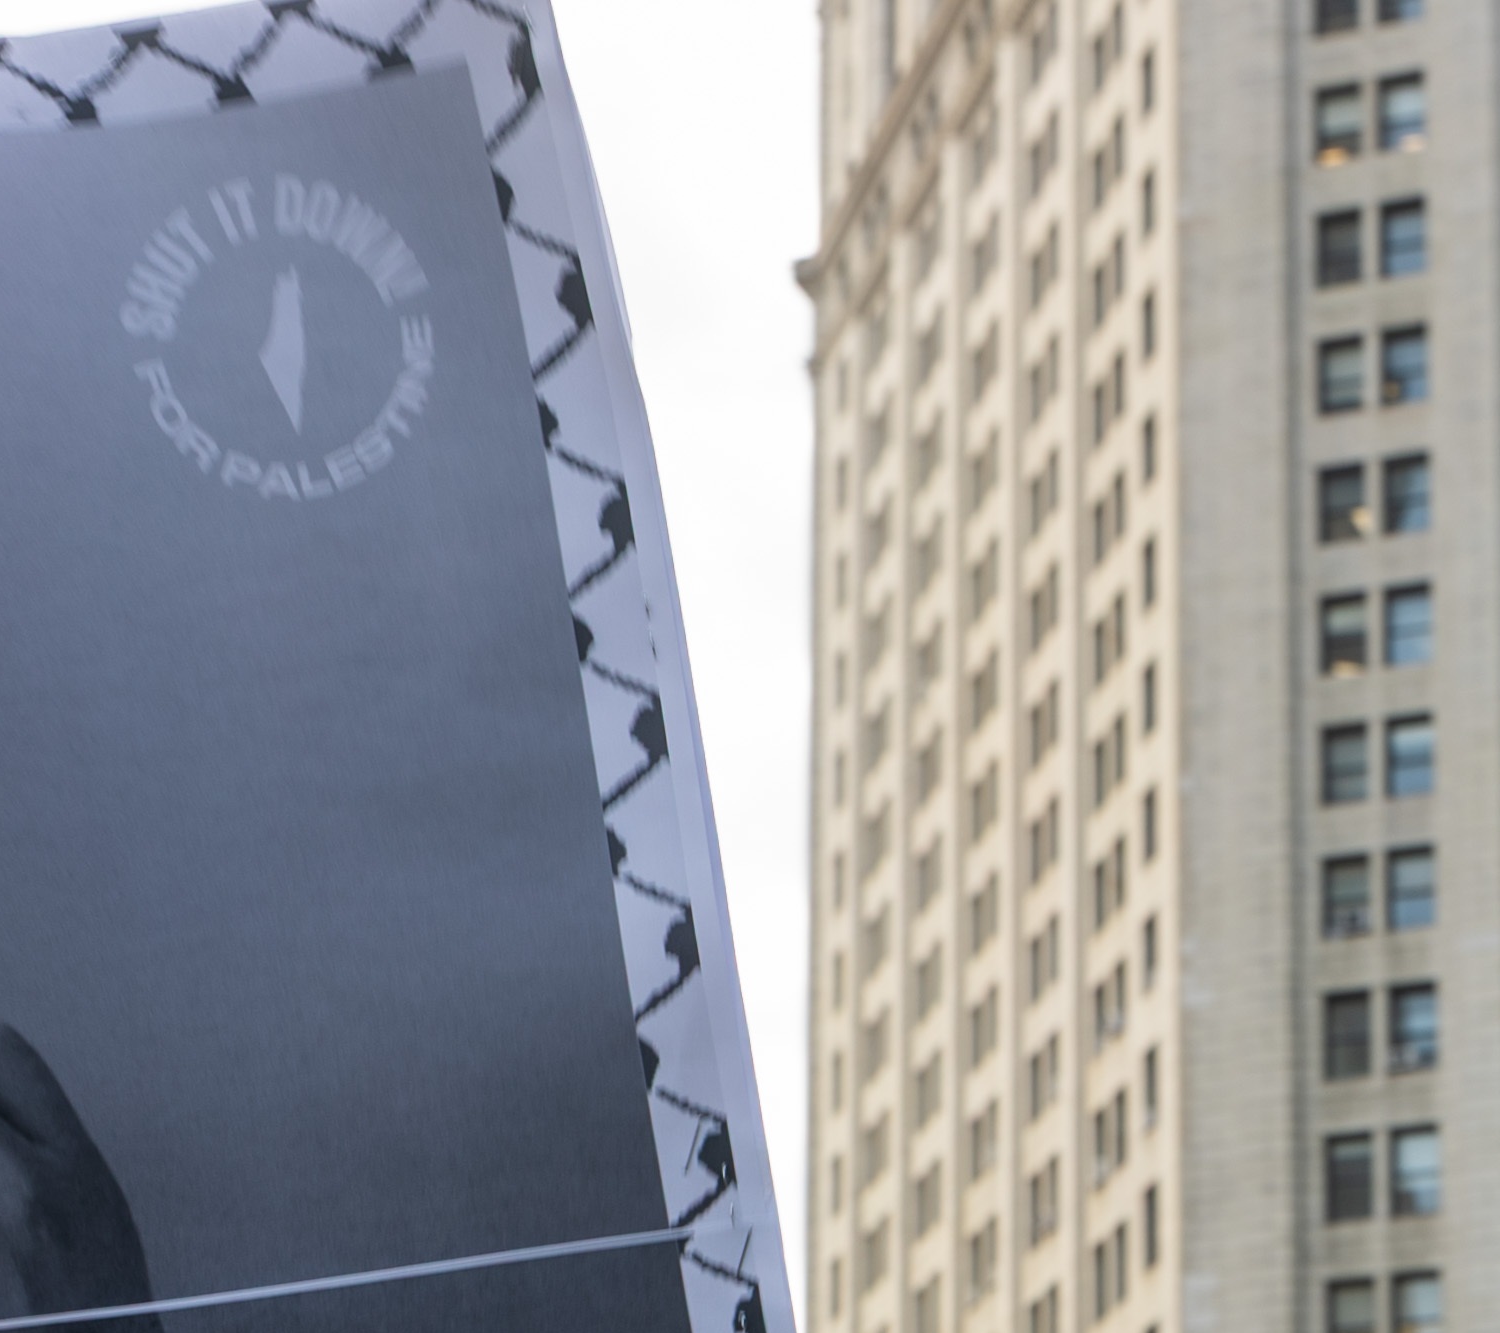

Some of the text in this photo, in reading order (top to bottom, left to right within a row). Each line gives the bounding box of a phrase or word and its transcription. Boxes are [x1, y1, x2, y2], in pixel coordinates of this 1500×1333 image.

[118, 205, 215, 342] SHUT
[207, 175, 259, 248] IT
[133, 313, 434, 500] FOR PALESTINE
